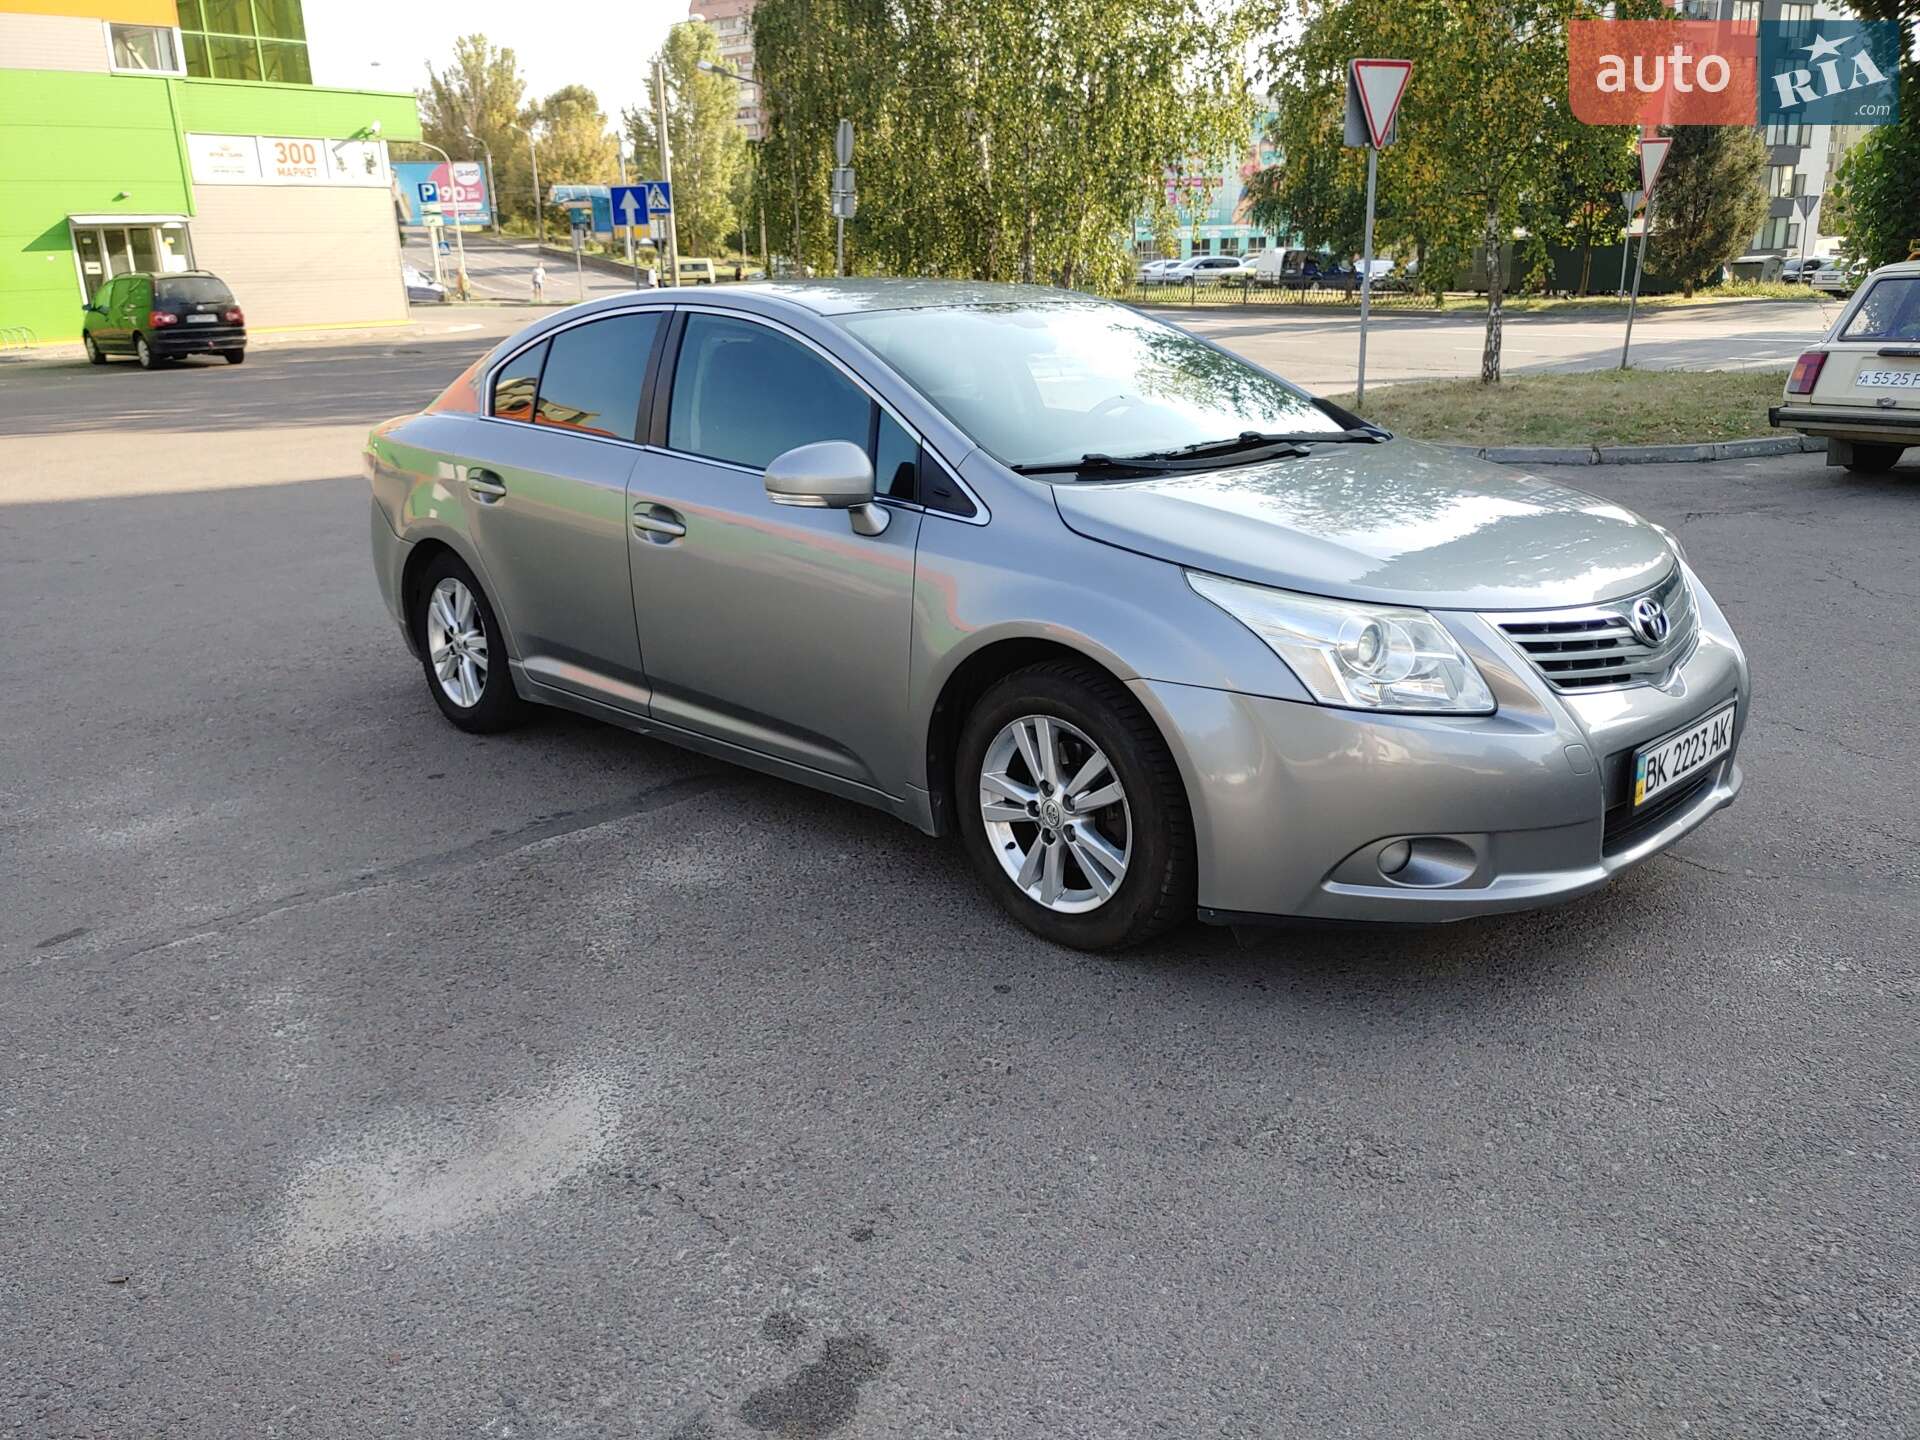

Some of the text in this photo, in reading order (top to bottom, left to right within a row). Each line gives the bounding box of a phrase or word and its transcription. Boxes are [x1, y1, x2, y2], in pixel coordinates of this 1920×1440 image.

[1872, 372, 1911, 386] 5525
[1646, 713, 1731, 793] BK 2223 AK
